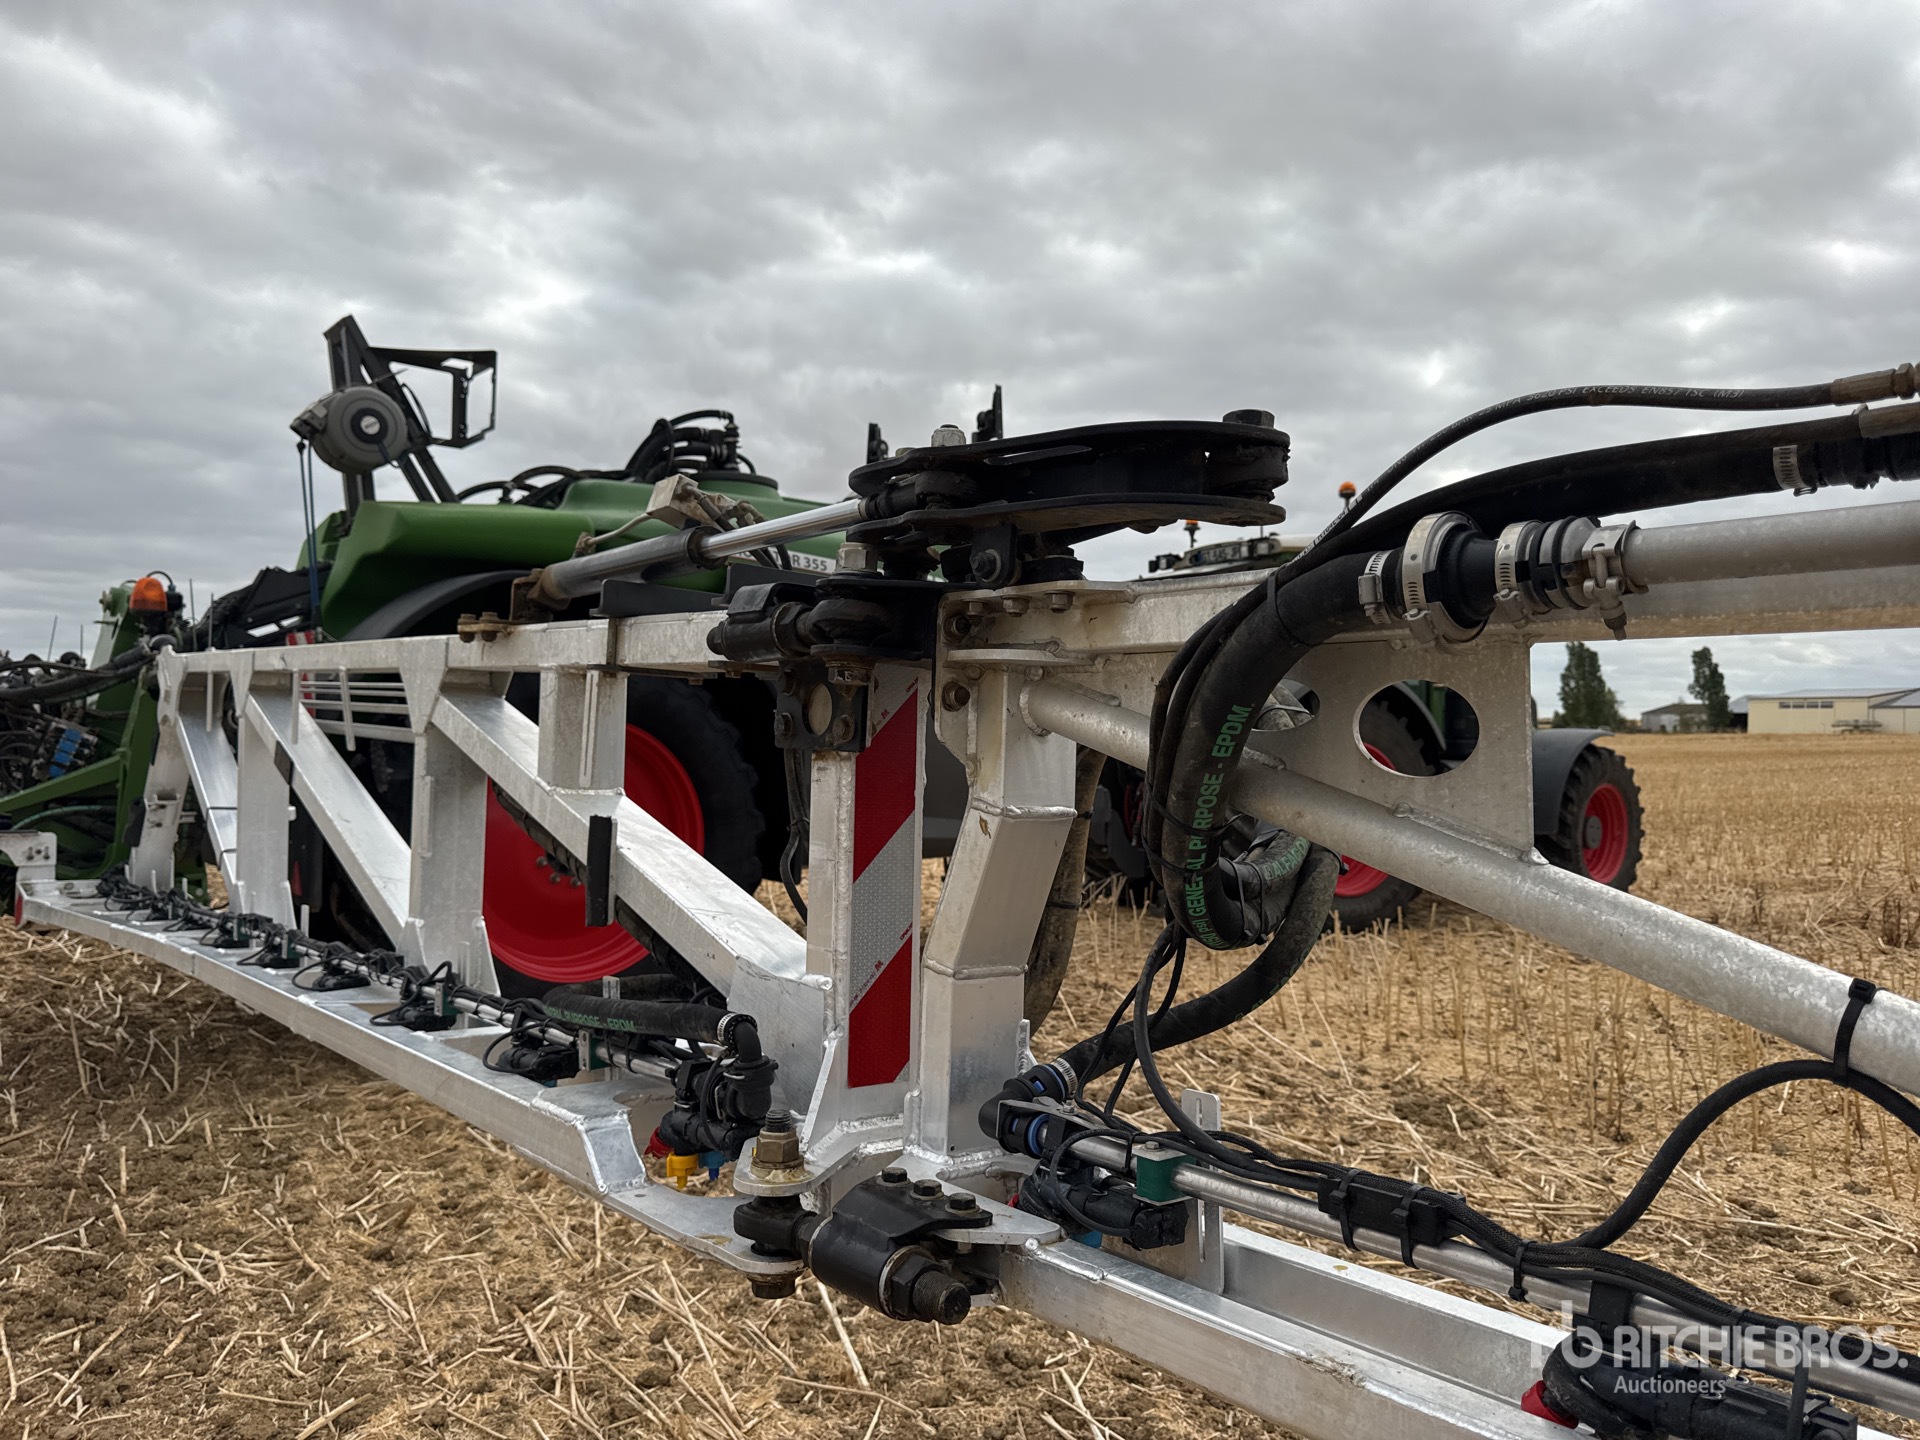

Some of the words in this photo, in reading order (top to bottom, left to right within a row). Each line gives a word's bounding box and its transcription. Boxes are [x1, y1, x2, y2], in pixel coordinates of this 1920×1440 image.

[1582, 386, 1635, 394] EXCEEDS
[803, 556, 828, 572] 355
[1212, 704, 1254, 758] EPDM
